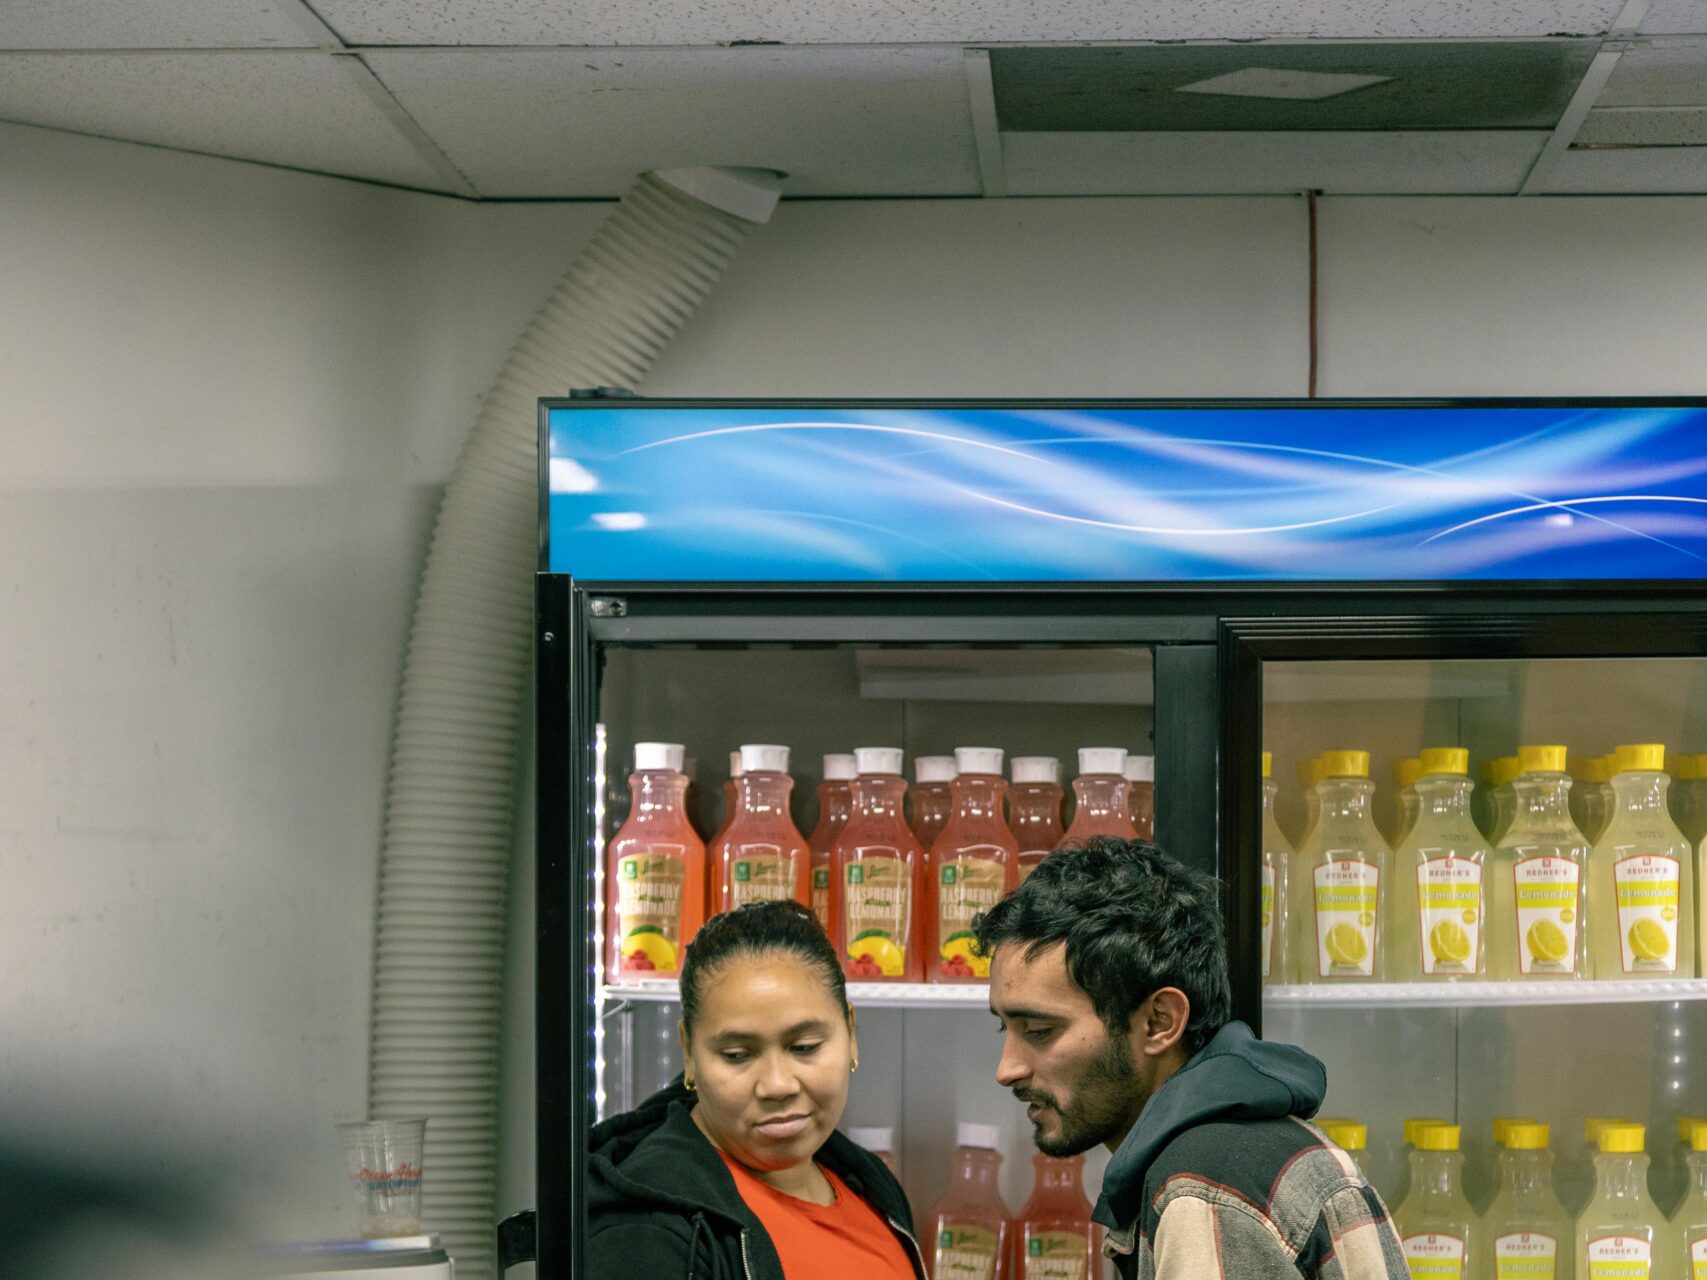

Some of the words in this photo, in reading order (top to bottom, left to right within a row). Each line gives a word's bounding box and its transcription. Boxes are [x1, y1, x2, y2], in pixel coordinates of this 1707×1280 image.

[1429, 870, 1470, 878] REDNER'S
[1526, 869, 1568, 877] REDNER'S
[1627, 867, 1668, 875] REDNER'S
[1423, 890, 1479, 901] Lemonade
[1519, 888, 1576, 899] Lemonade
[1620, 887, 1676, 898] Lemonade
[1409, 1264, 1460, 1273] emonade
